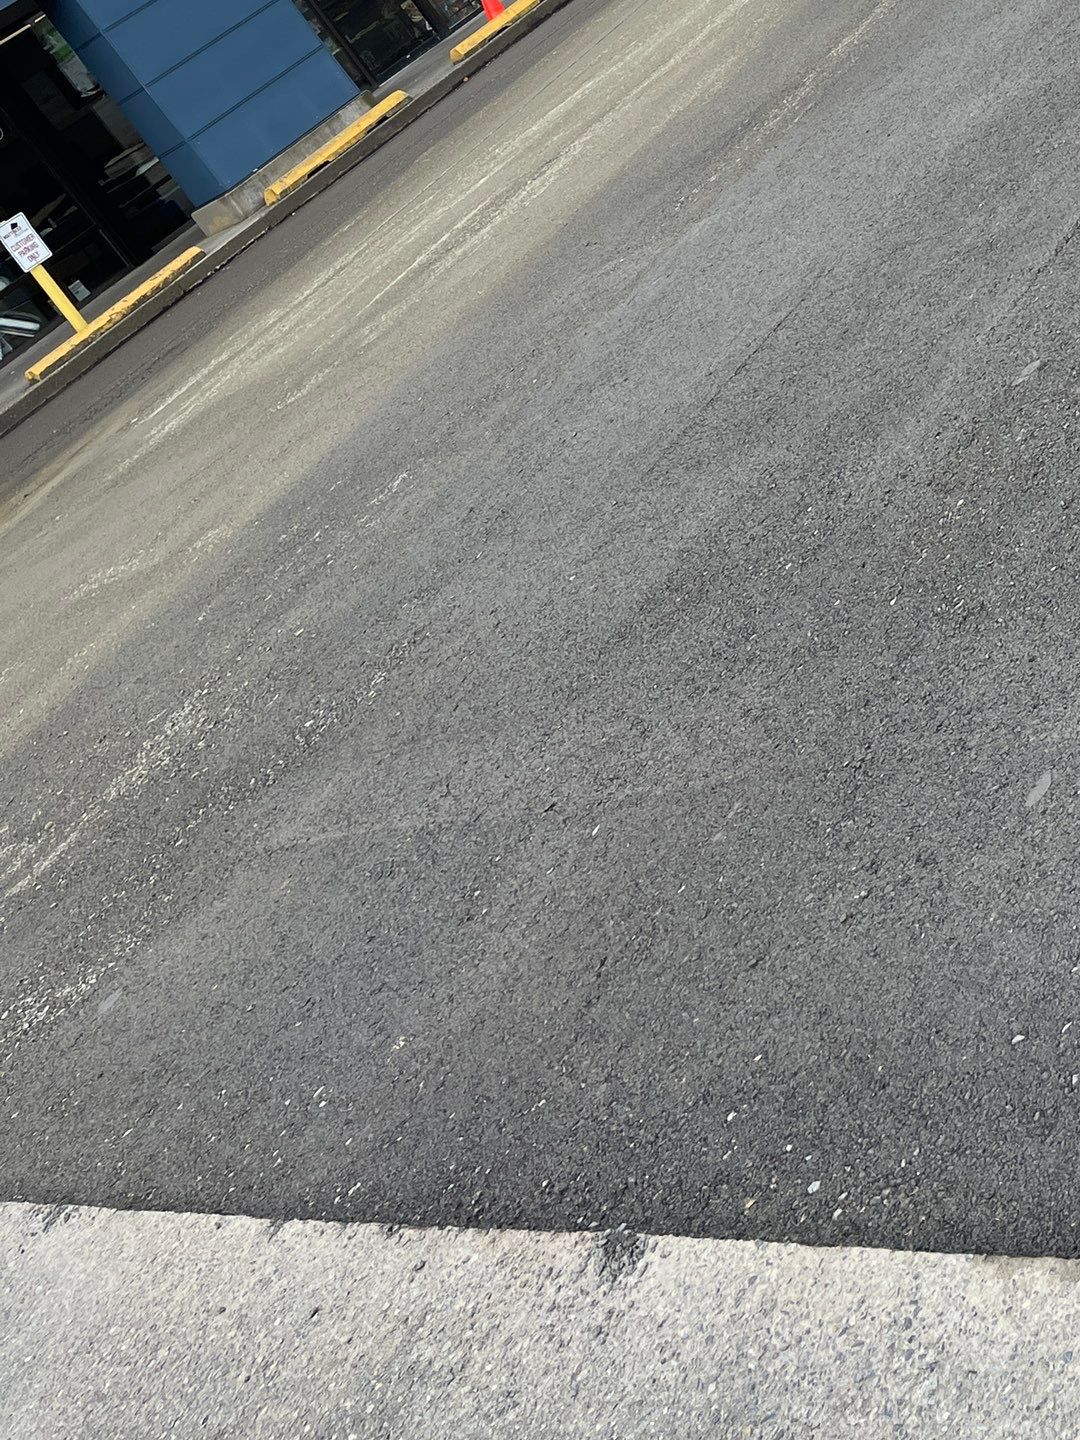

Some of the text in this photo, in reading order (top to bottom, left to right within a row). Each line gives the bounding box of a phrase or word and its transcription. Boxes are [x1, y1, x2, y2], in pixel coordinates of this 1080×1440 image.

[10, 233, 35, 252] CUSTOMER
[18, 241, 39, 257] PARKING
[27, 251, 40, 262] ONLY
